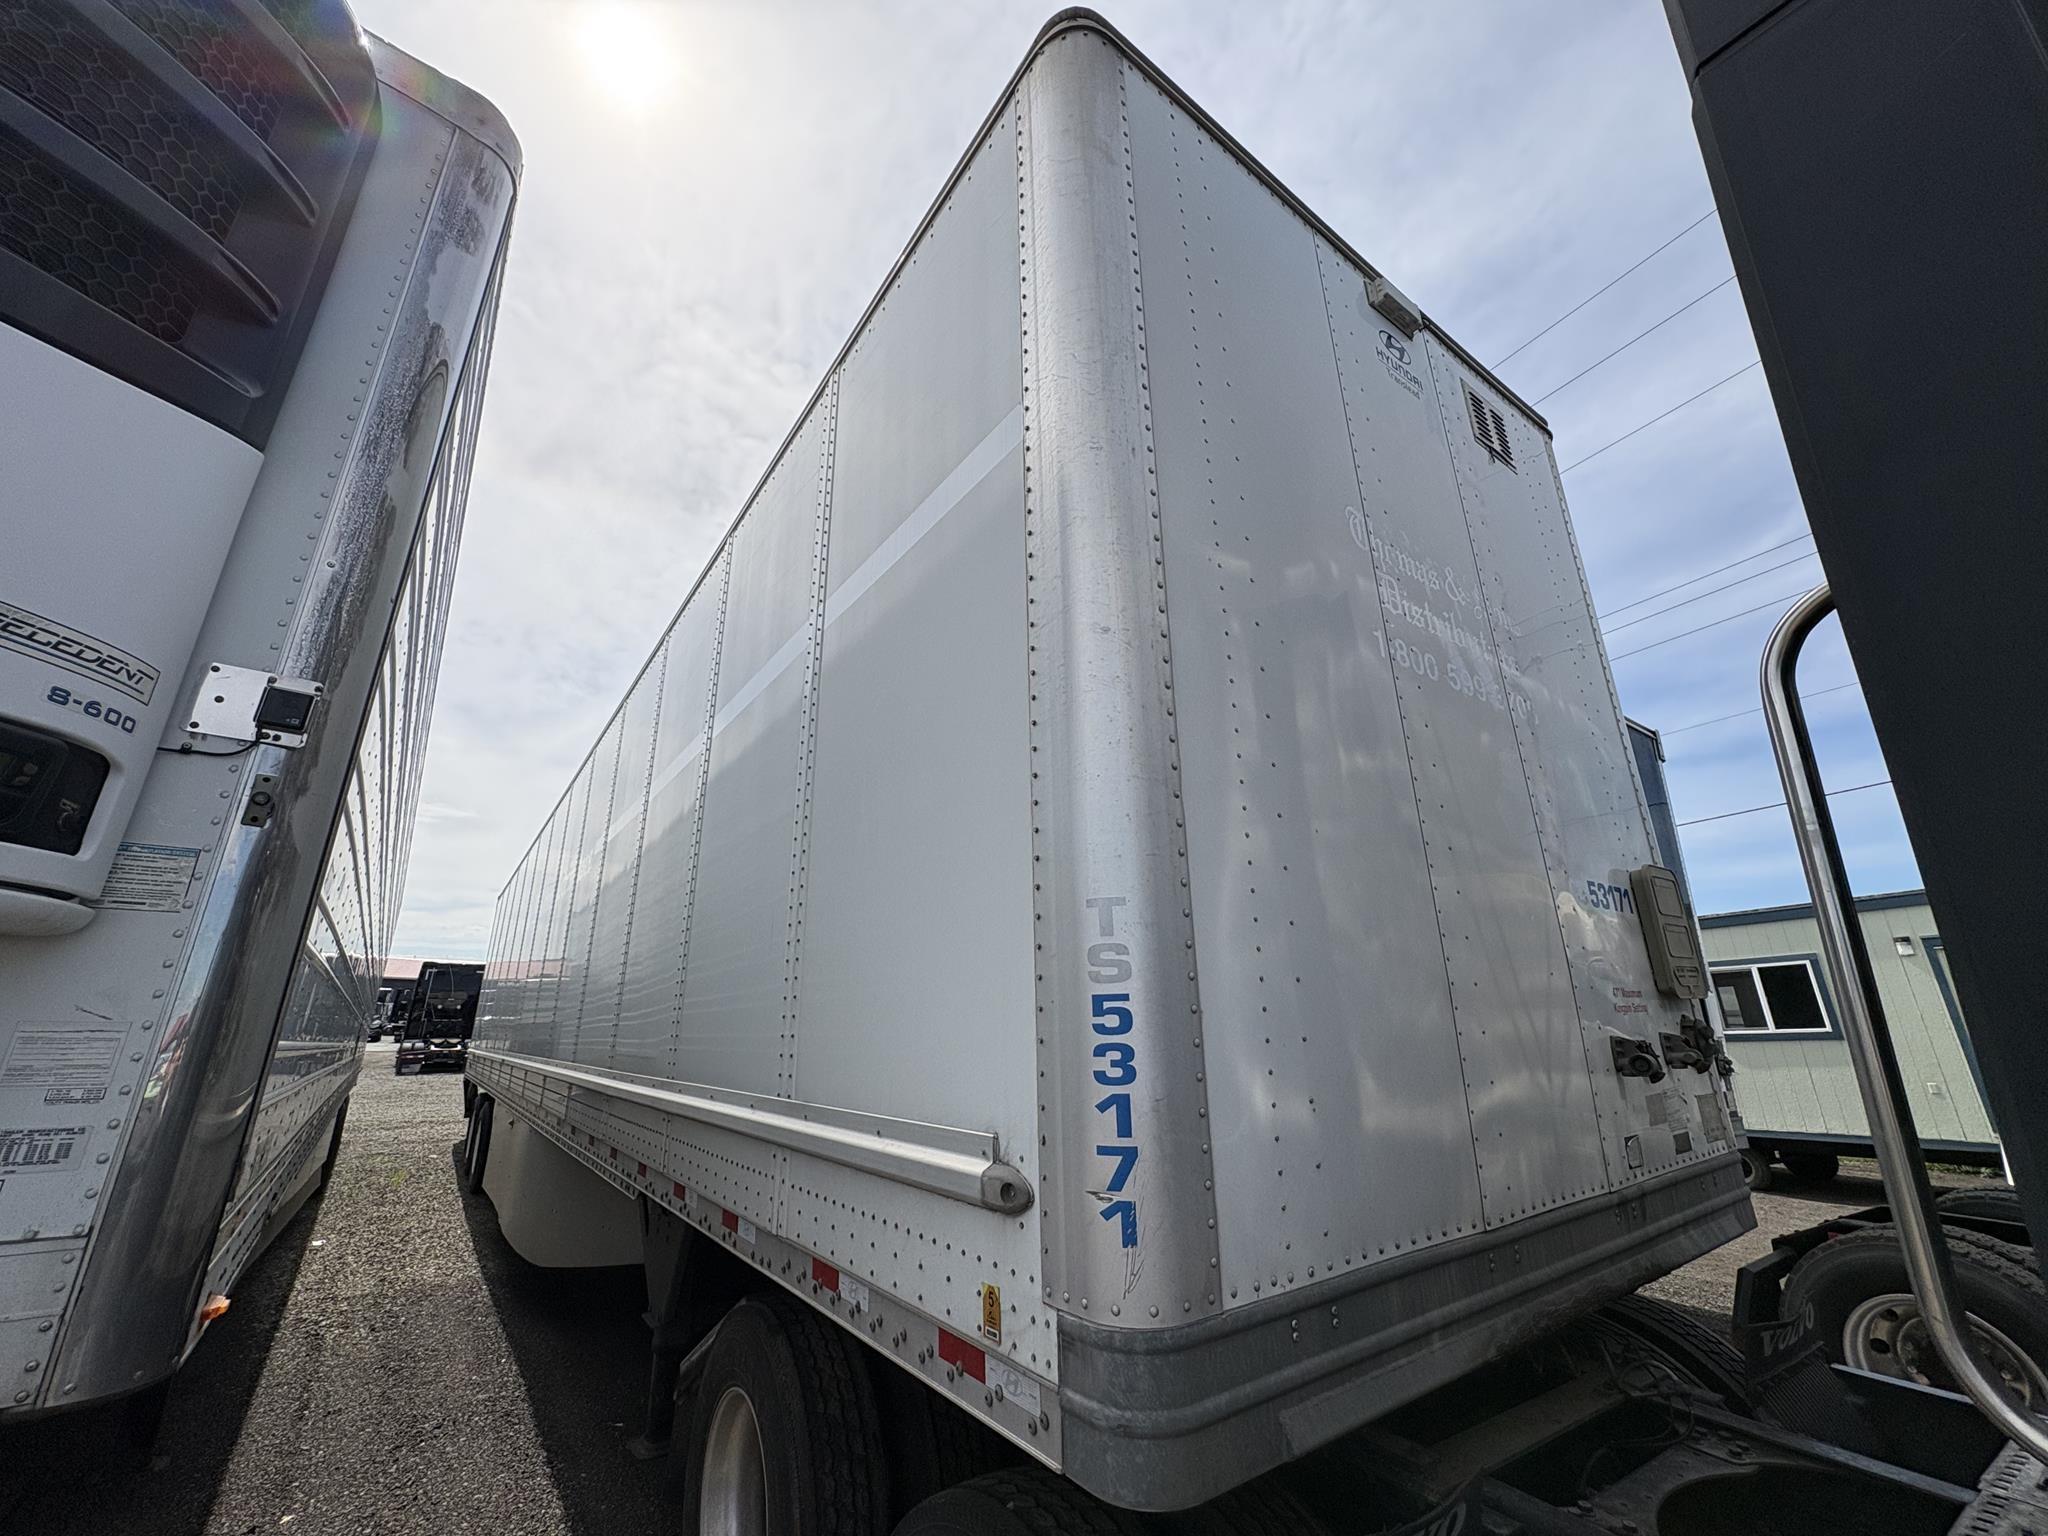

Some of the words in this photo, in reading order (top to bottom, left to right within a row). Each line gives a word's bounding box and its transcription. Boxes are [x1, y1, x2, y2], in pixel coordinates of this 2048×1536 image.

[1376, 346, 1424, 391] HYUNDAI
[47, 685, 137, 734] S-600
[1586, 880, 1634, 914] 53171
[988, 1290, 995, 1307] 5
